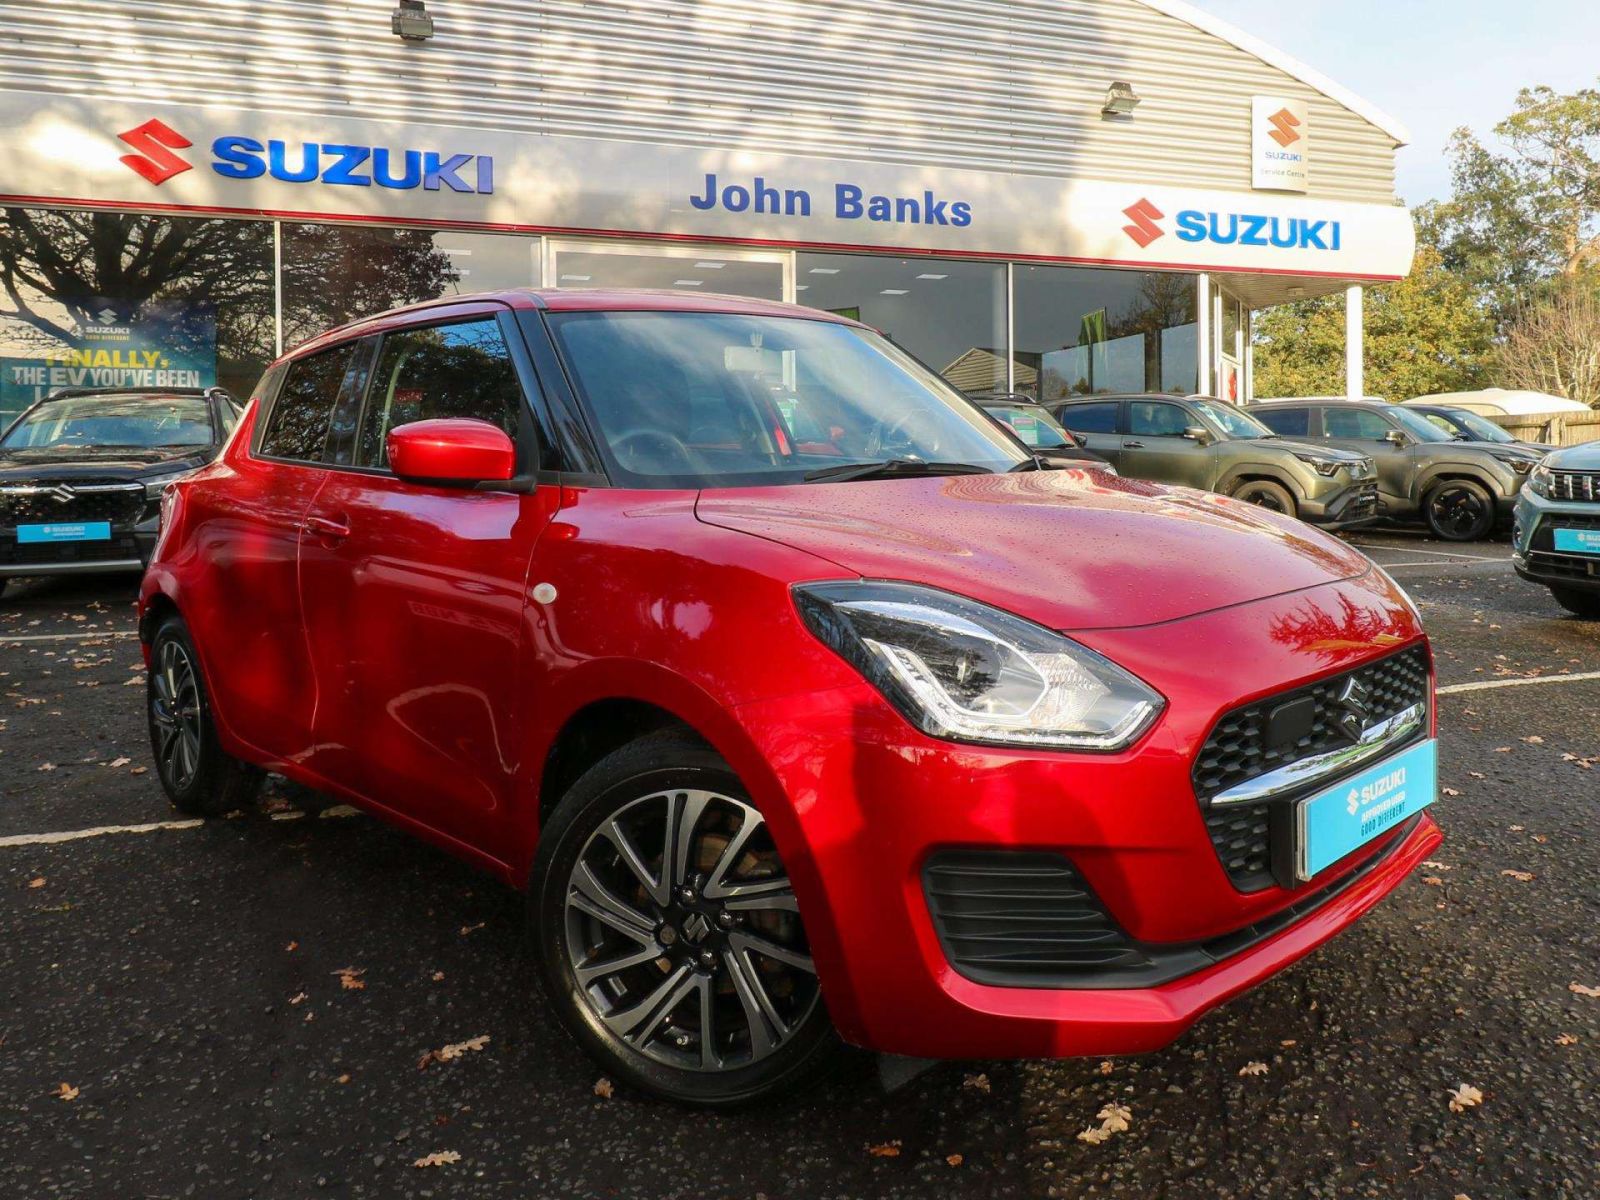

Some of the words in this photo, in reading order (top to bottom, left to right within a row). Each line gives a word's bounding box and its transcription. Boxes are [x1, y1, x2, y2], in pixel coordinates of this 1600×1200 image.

[212, 136, 493, 195] SUZUKI
[1264, 151, 1302, 162] SUZUKI
[689, 173, 811, 217] John
[835, 183, 972, 227] Banks
[1175, 209, 1341, 251] SUZUKI
[85, 326, 130, 334] SUZUKI
[12, 366, 46, 385] THE
[50, 367, 88, 386] EV
[89, 368, 153, 388] YOU'VE
[155, 369, 200, 388] BEEN
[1361, 767, 1406, 805] SUZUKI
[1361, 818, 1376, 837] GOOD
